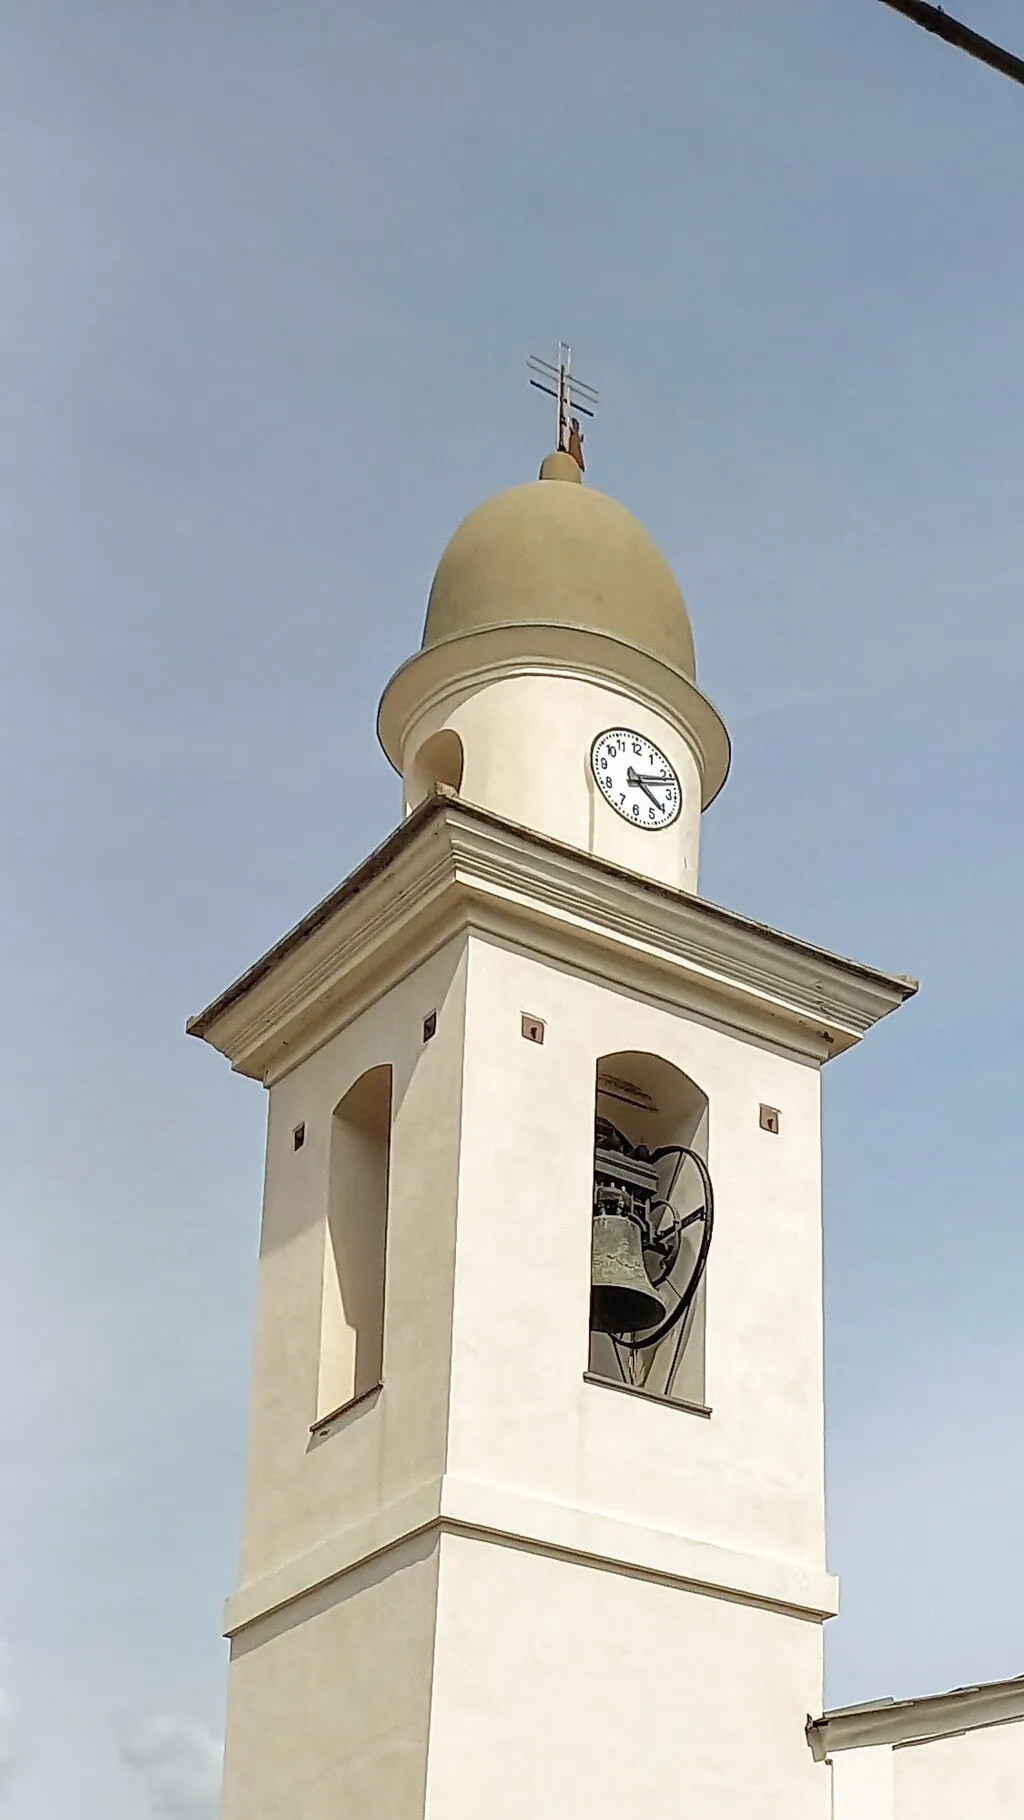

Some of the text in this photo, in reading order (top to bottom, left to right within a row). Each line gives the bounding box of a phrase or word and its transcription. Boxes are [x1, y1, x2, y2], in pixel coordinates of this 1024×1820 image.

[606, 744, 617, 758] 10
[617, 739, 626, 753] 11
[631, 742, 642, 757] 12
[600, 757, 608, 770] 9
[649, 753, 654, 766] 1
[605, 776, 613, 789] 8
[620, 793, 626, 806] 7
[665, 789, 672, 801] 3
[632, 804, 640, 816] 6
[648, 807, 656, 820] 5
